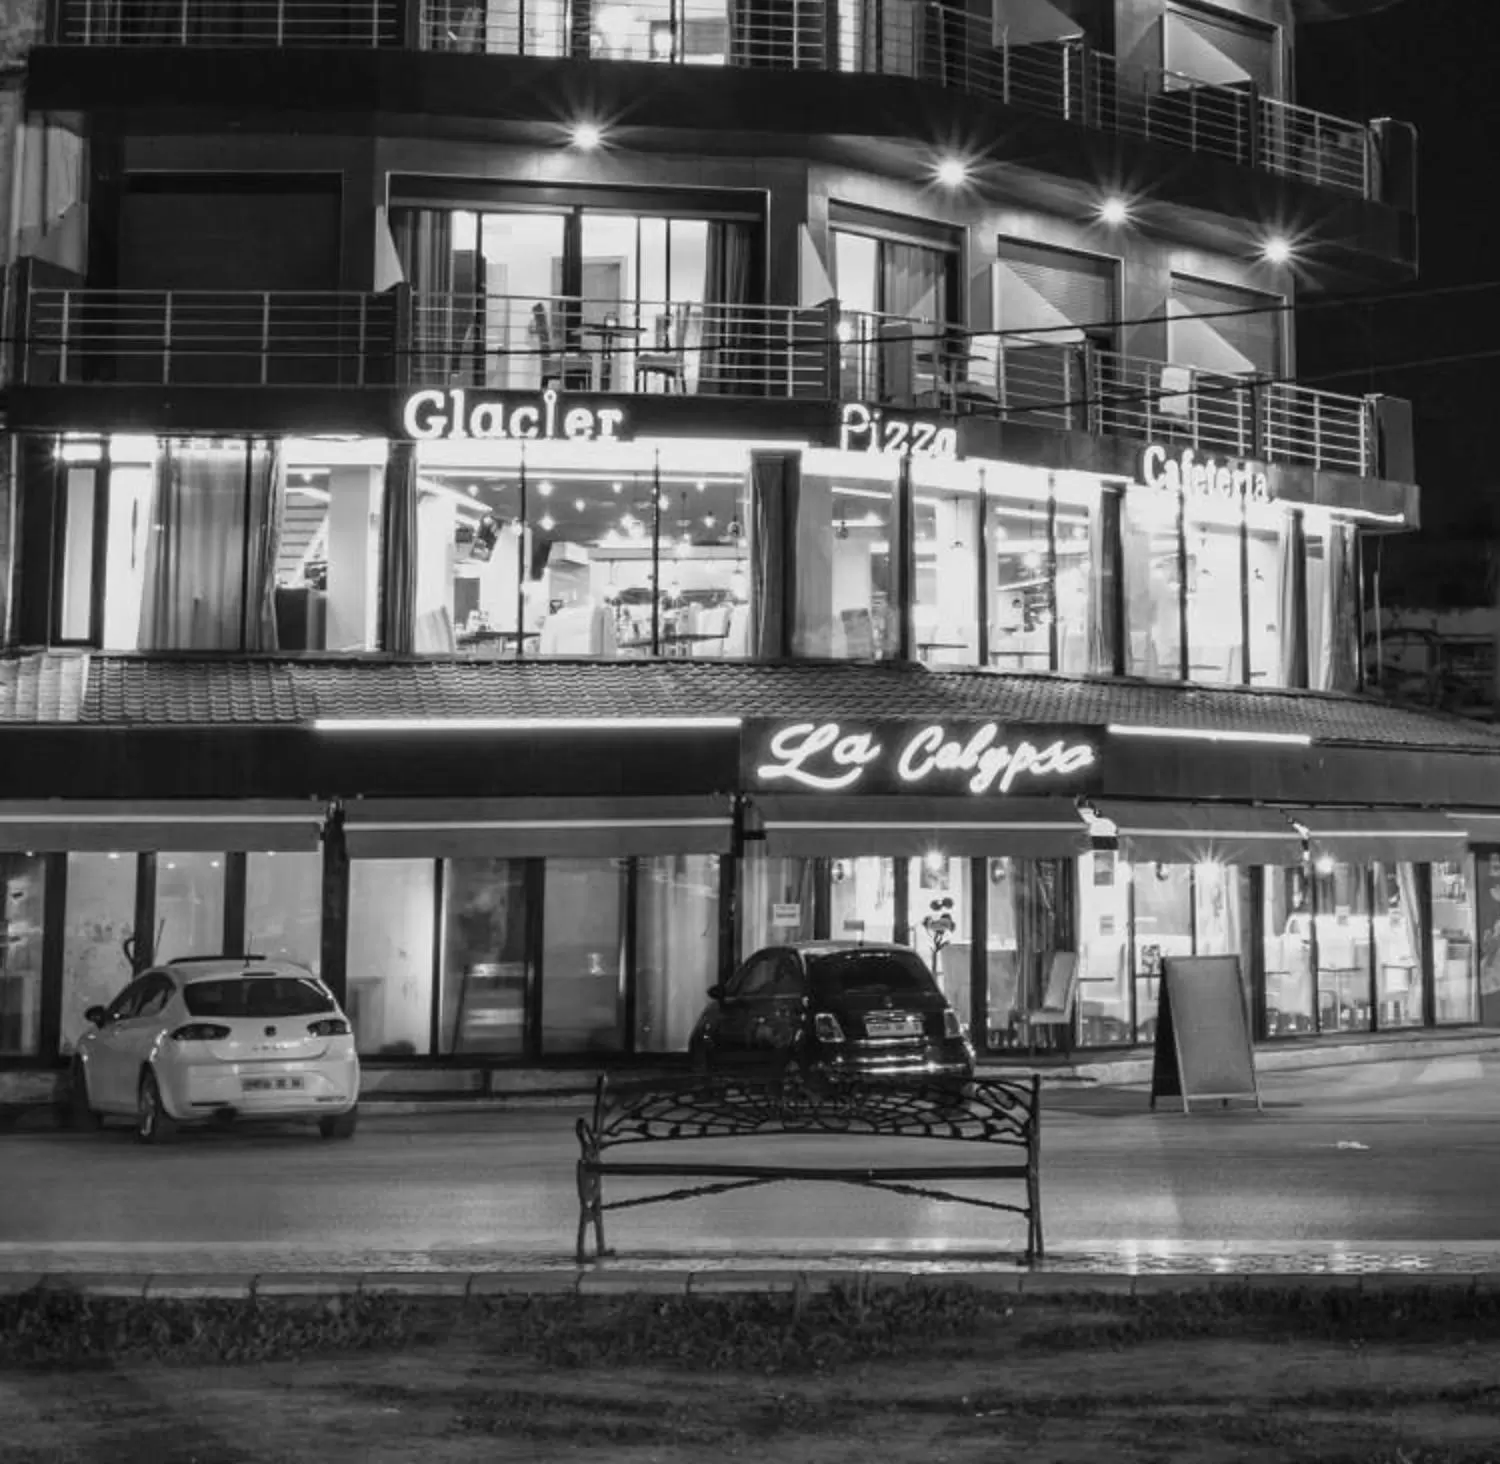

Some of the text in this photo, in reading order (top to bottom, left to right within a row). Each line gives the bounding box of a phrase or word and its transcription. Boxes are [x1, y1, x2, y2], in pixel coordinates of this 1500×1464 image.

[403, 388, 624, 440] Glacier
[840, 403, 958, 458] Pizza
[757, 722, 1096, 794] La Calypso
